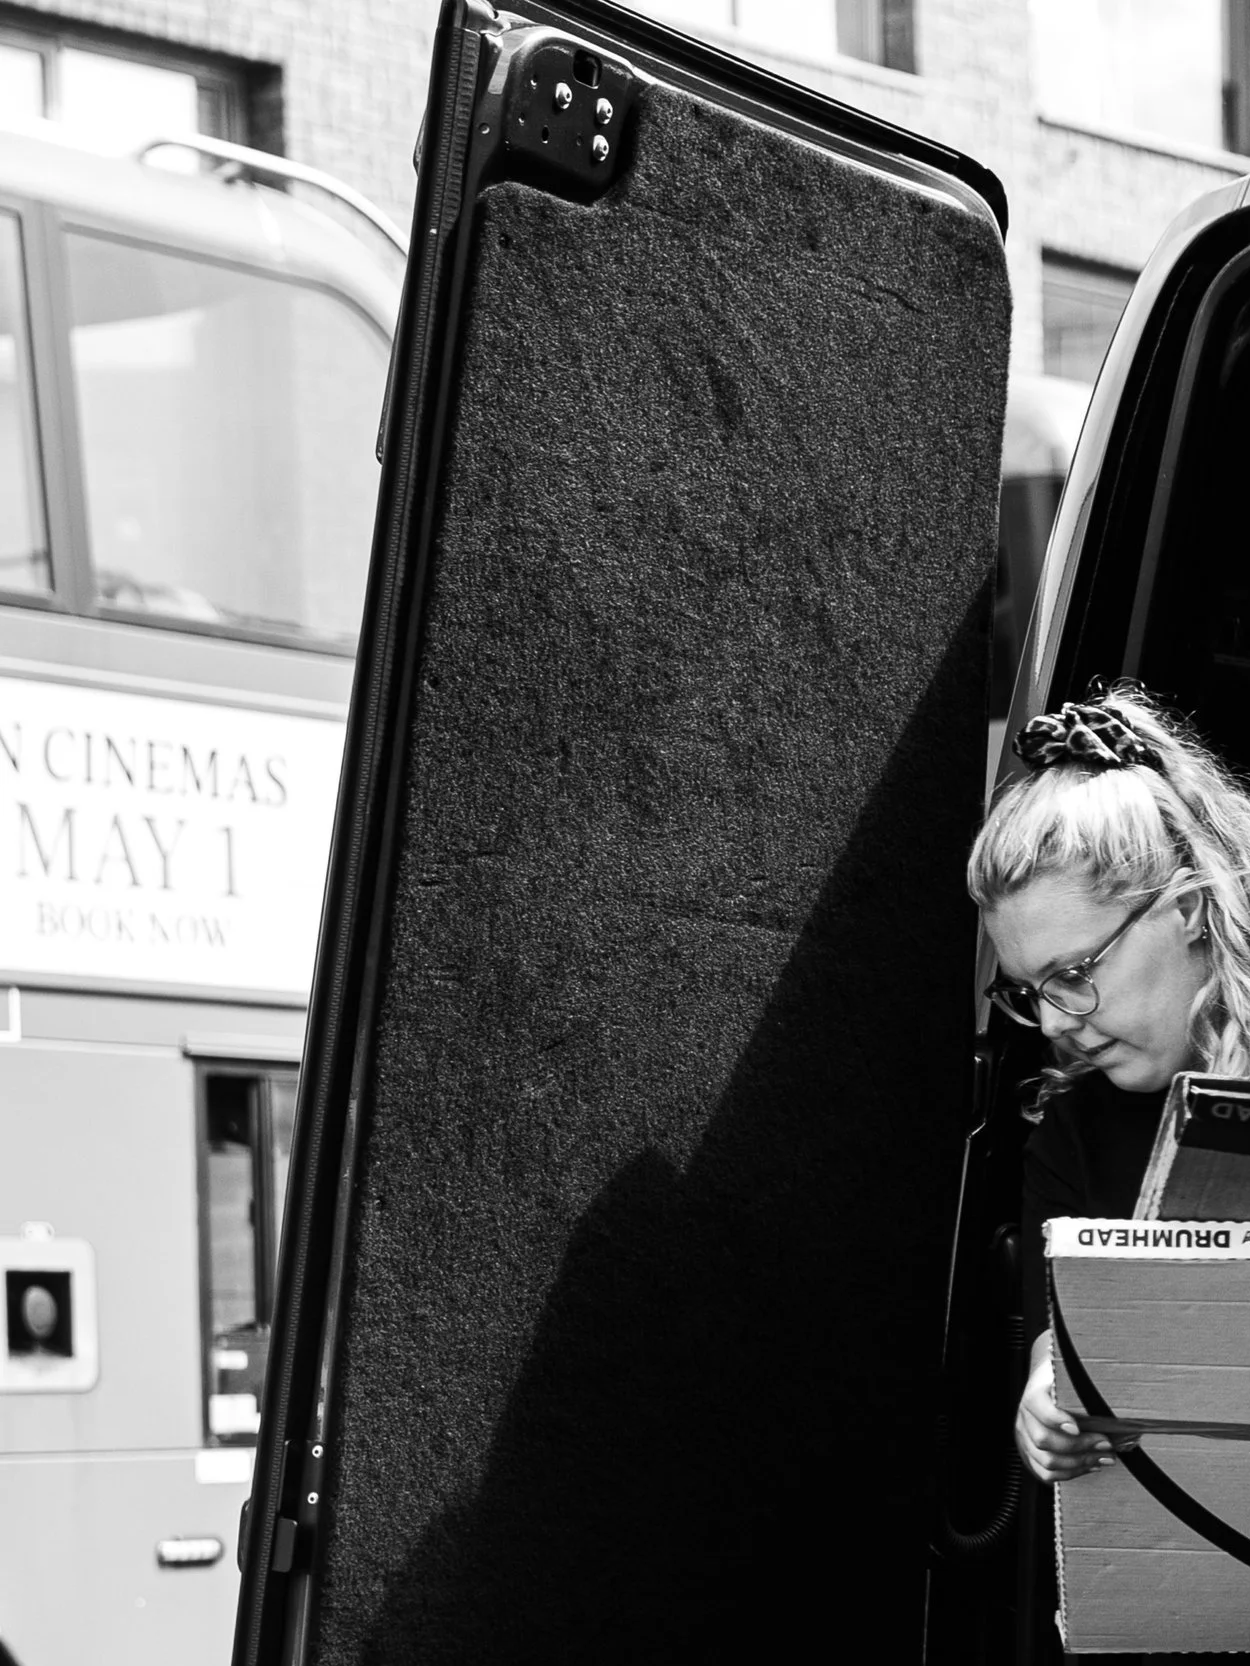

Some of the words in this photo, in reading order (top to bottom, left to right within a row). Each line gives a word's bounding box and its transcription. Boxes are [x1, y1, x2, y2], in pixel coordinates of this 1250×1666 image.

[43, 727, 288, 806] CINEMAS
[16, 801, 187, 892] MAY
[217, 826, 244, 899] 1
[36, 901, 136, 944] BOOK
[149, 912, 232, 947] NOW
[1078, 1229, 1231, 1248] DRUMHEAD
